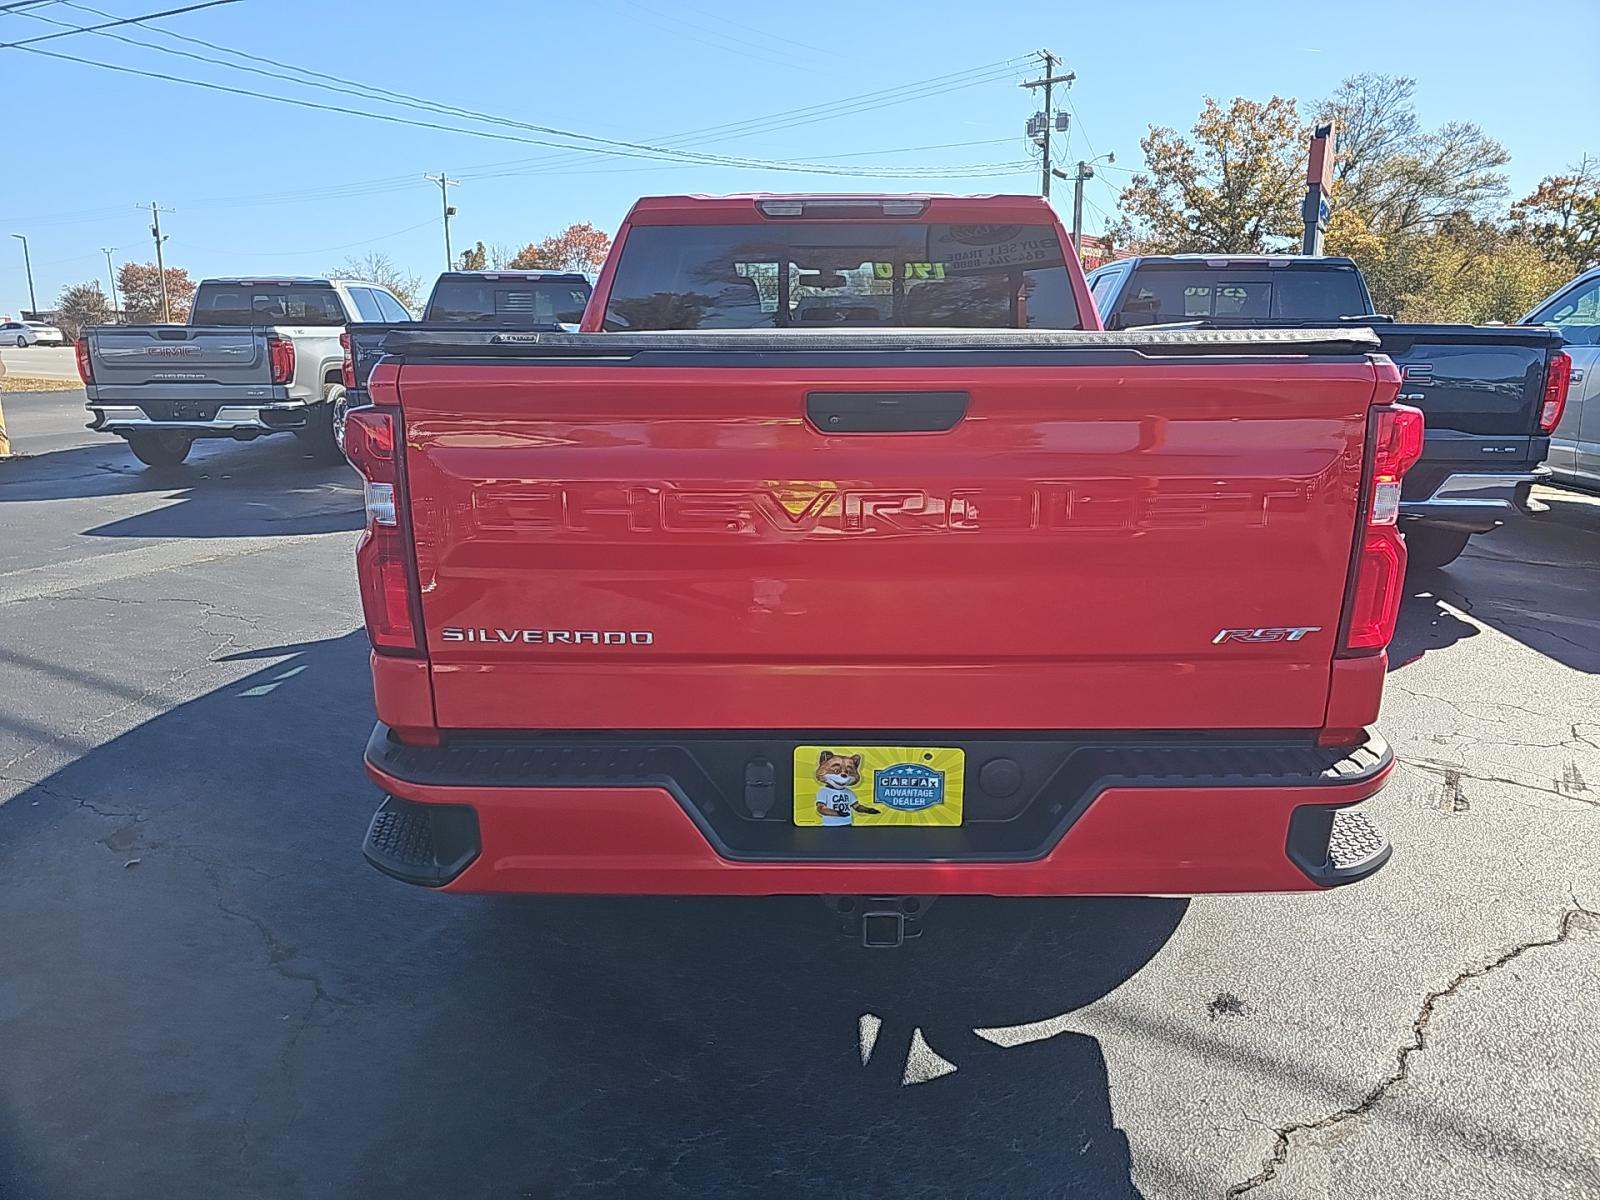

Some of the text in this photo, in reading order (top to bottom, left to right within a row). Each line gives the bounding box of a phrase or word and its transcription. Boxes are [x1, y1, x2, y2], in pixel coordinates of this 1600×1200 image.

[471, 488, 1301, 533] CHEVROLET
[441, 627, 655, 646] SILVERADO
[1211, 626, 1322, 644] RST
[880, 777, 939, 788] CARFAX
[884, 788, 935, 797] ADVANTAGE
[832, 794, 850, 803] CAR
[892, 797, 926, 806] DEALER
[832, 803, 851, 812] FOX
